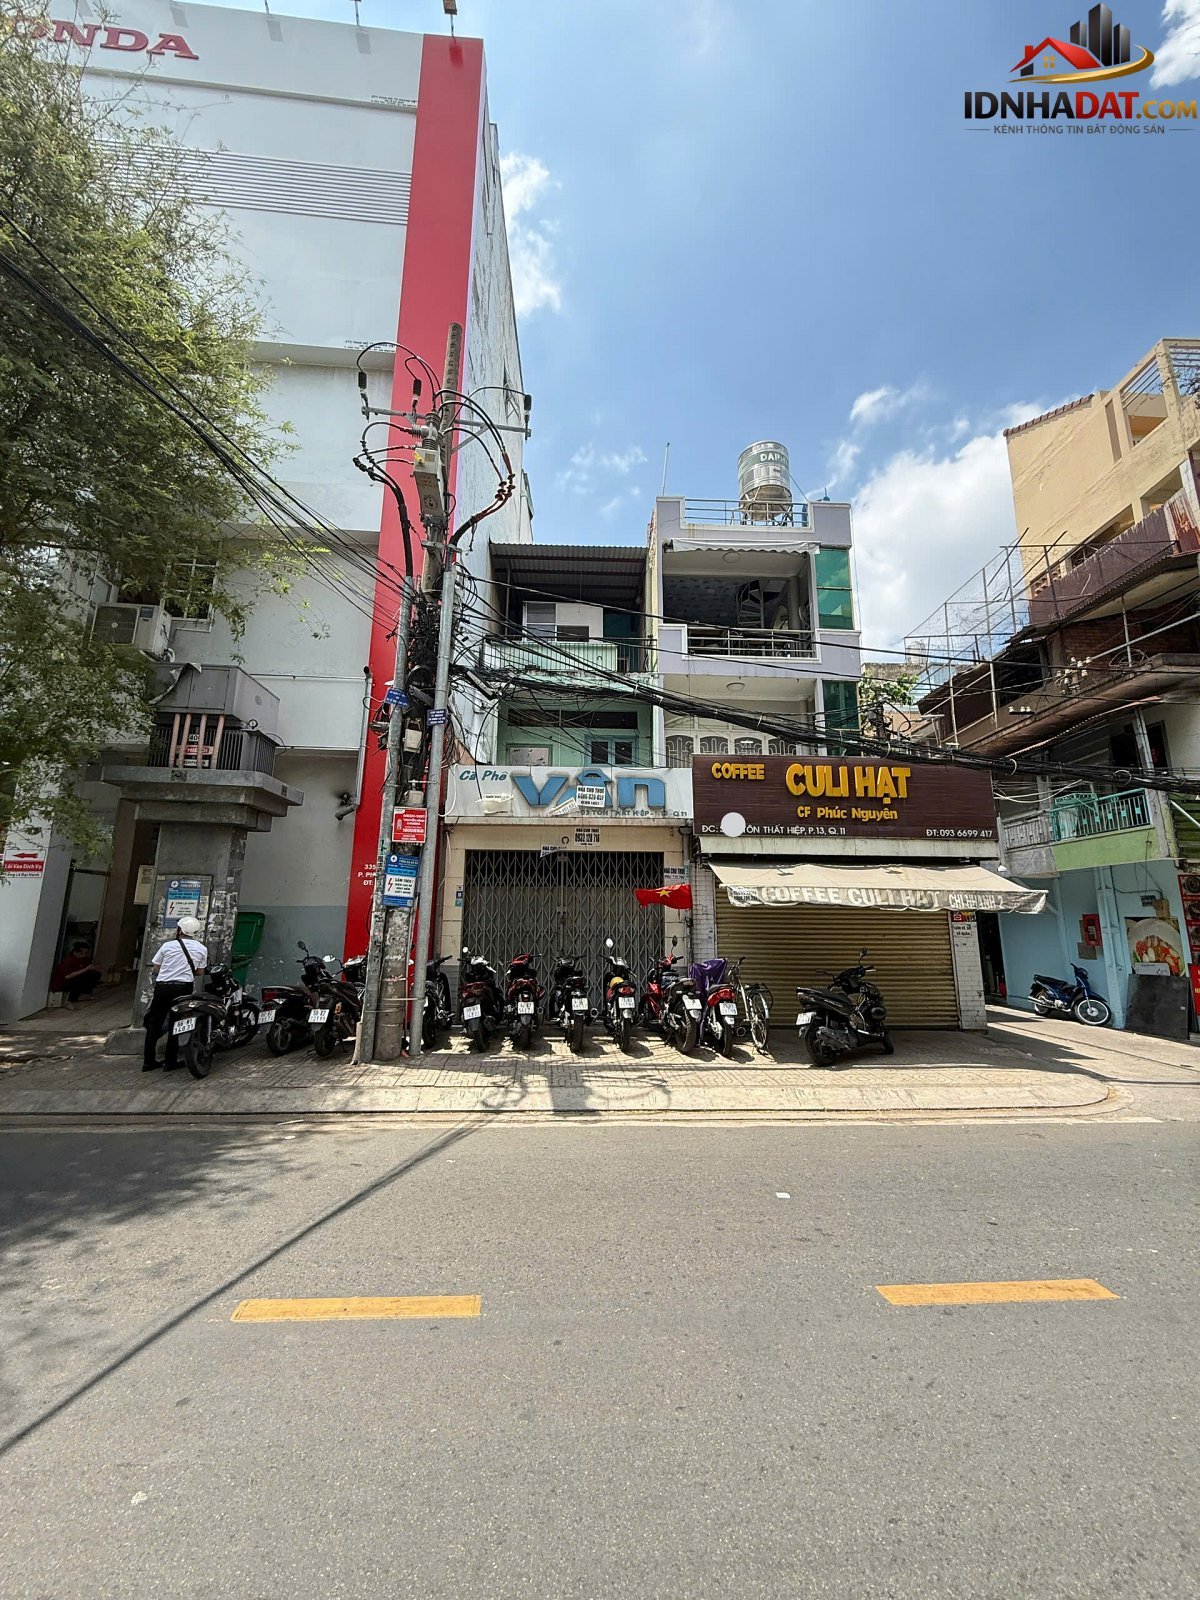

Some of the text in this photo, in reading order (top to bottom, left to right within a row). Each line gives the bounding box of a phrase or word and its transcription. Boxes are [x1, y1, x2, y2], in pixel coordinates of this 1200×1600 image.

[481, 769, 509, 781] Phê
[711, 762, 765, 780] COFFEE
[785, 763, 911, 804] CULI HẠT
[797, 805, 898, 822] CF Phúc Nguyên
[701, 824, 719, 833] ĐC:
[763, 823, 785, 834] THẤT
[787, 824, 807, 836] HIỆP,
[957, 829, 978, 838] 6699
[980, 829, 993, 838] 417
[762, 886, 841, 903] COFFEE
[847, 888, 897, 906] CULI
